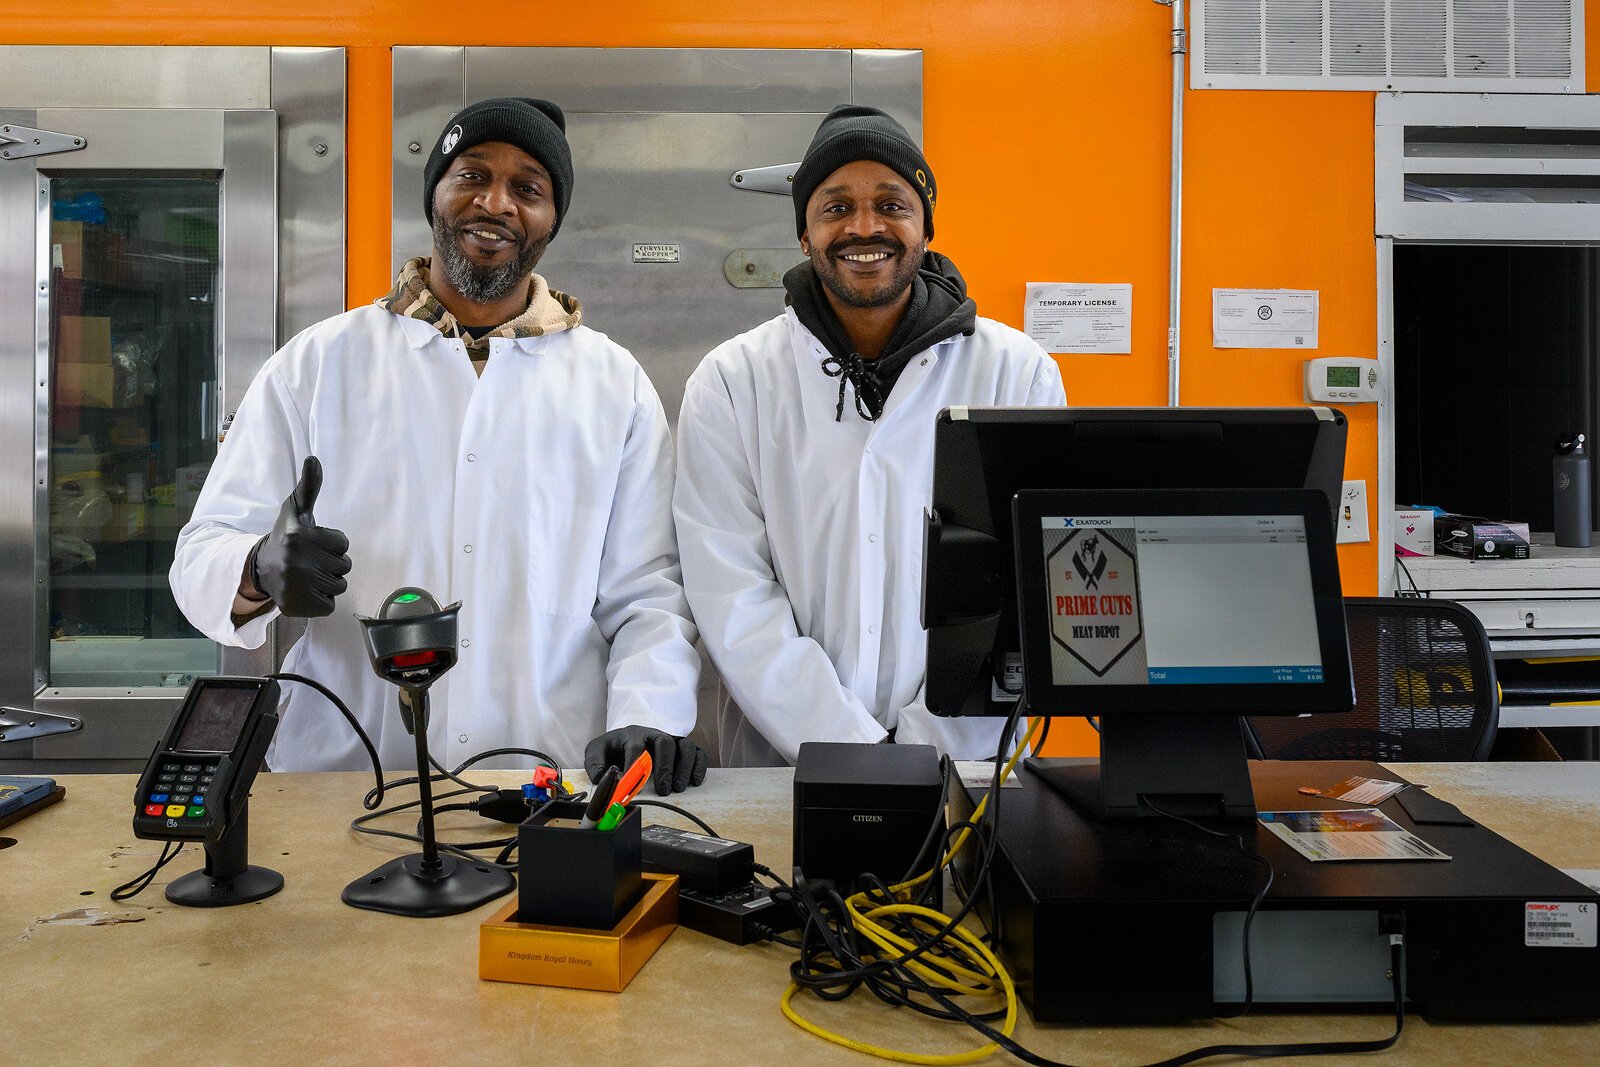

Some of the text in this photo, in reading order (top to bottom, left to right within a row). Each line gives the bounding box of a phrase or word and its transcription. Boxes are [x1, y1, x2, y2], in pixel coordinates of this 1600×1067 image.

[1039, 299, 1082, 307] TEMPORARY
[1056, 595, 1133, 616] PRIME CUTS
[1072, 625, 1120, 639] MEAT DEPOT
[1149, 671, 1167, 679] Total
[852, 814, 883, 822] CITIZEN
[507, 951, 592, 966] Kingdom Royal Honey
